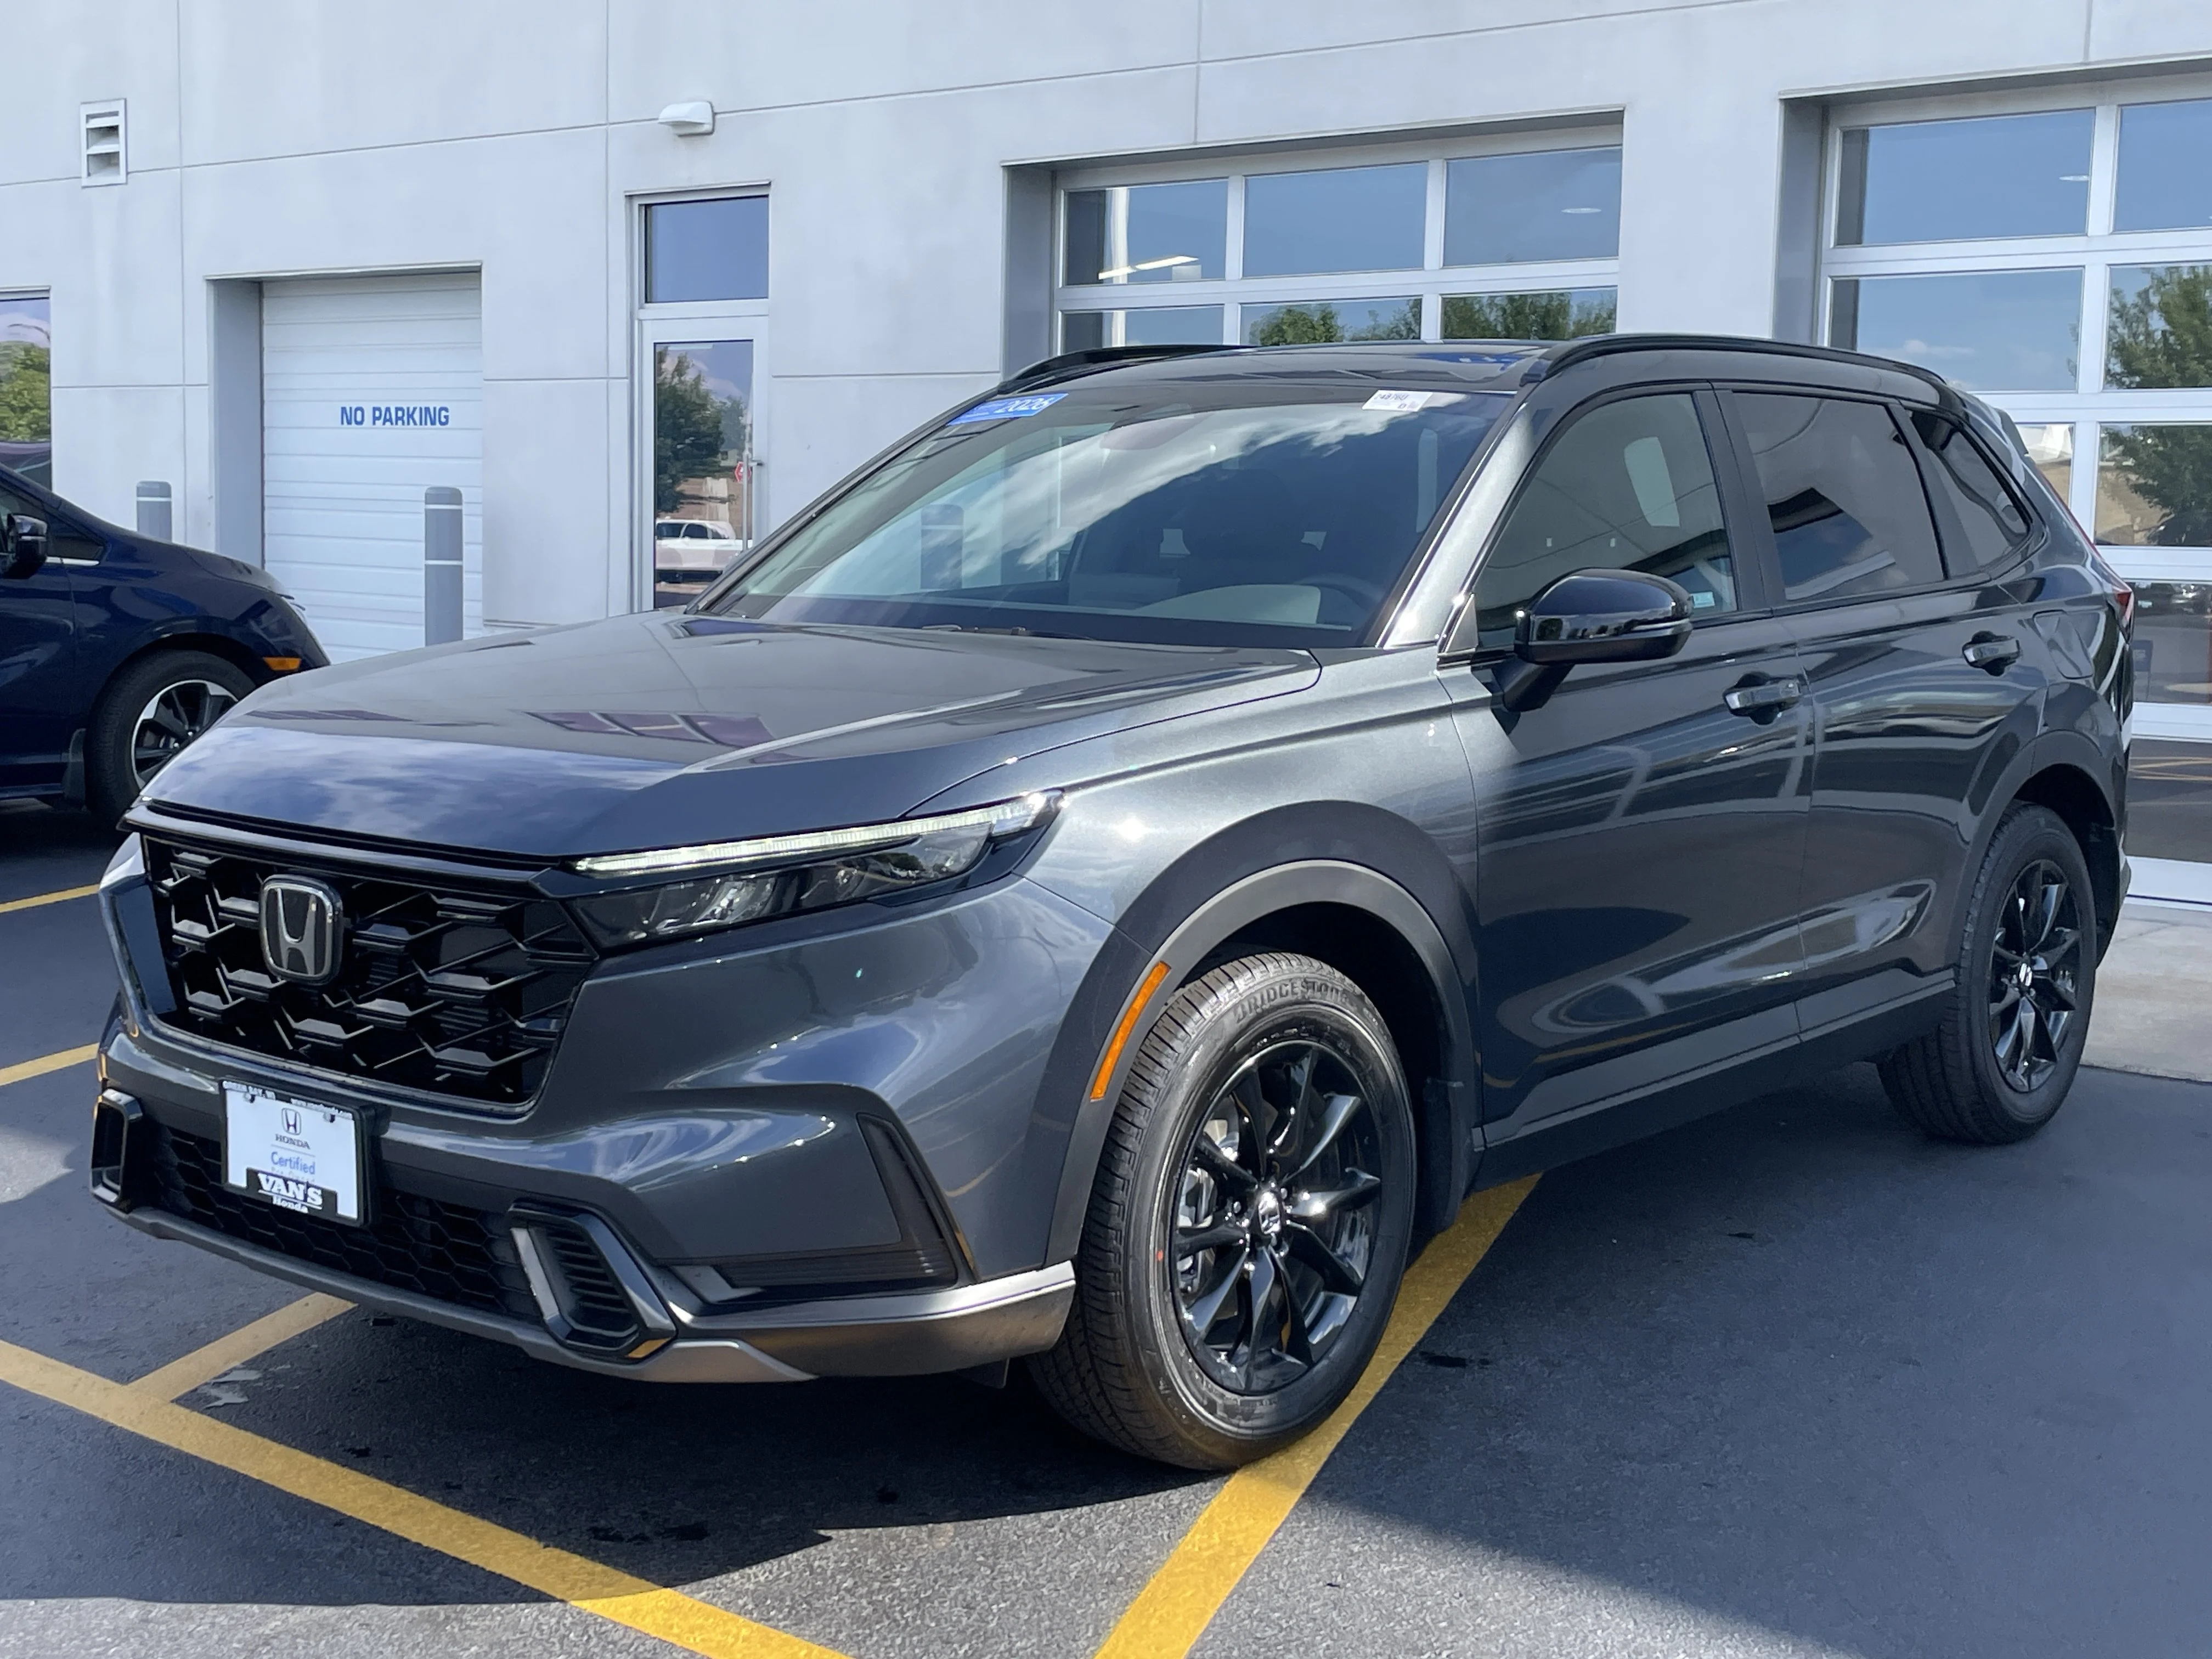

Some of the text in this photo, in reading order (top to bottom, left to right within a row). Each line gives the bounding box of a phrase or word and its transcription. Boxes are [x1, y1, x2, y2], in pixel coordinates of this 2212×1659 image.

[340, 406, 450, 426] NO PARKING
[275, 1133, 311, 1150] HONDA
[271, 1151, 315, 1174] Certified
